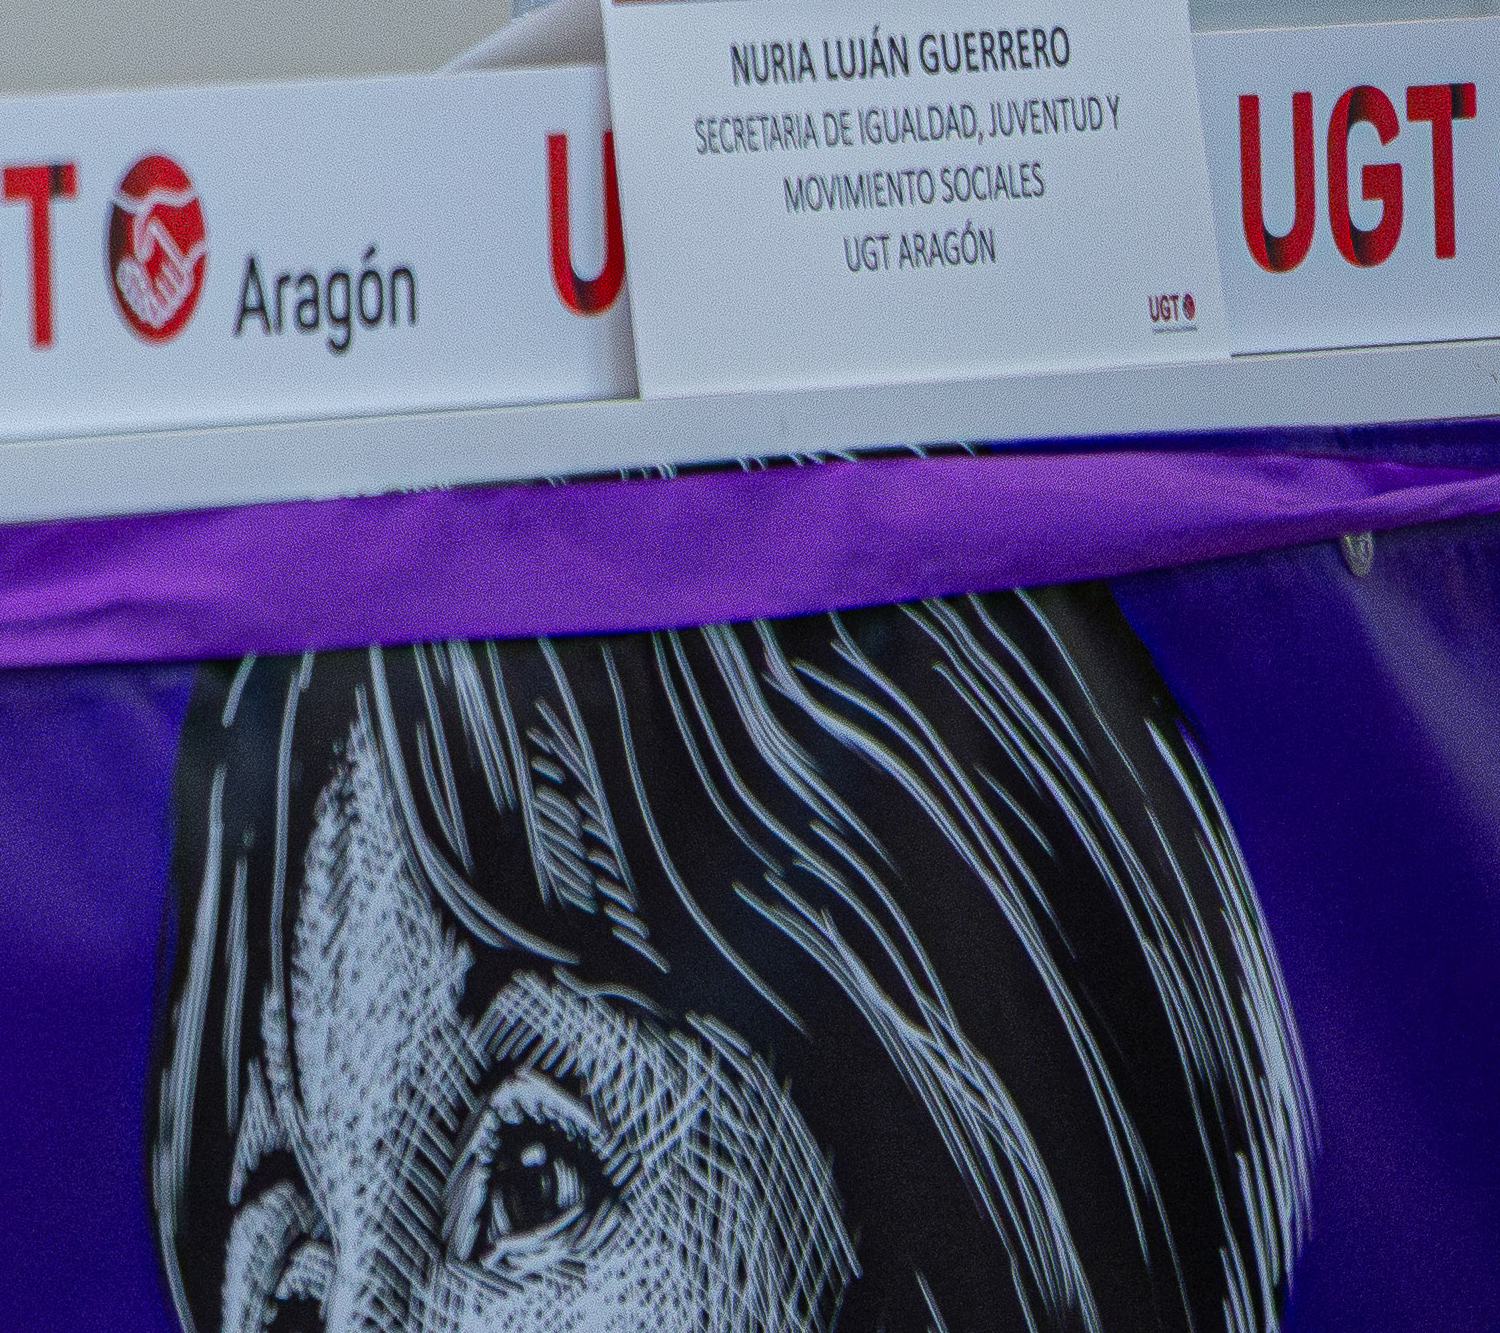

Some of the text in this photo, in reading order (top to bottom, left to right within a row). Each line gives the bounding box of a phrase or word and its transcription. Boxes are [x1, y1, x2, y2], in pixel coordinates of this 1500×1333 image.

[730, 24, 1071, 85] NURIA LUJÁN GUERRERO
[694, 93, 1121, 156] SECRETARIA DE IGUALDAD, JUVENTUD Y
[783, 161, 1045, 213] MOVIMIENTO SOCIALES
[1237, 81, 1478, 274] UGT
[843, 219, 997, 273] UGT ARAGÓN
[233, 244, 418, 356] Aragón
[1148, 293, 1179, 322] UGT
